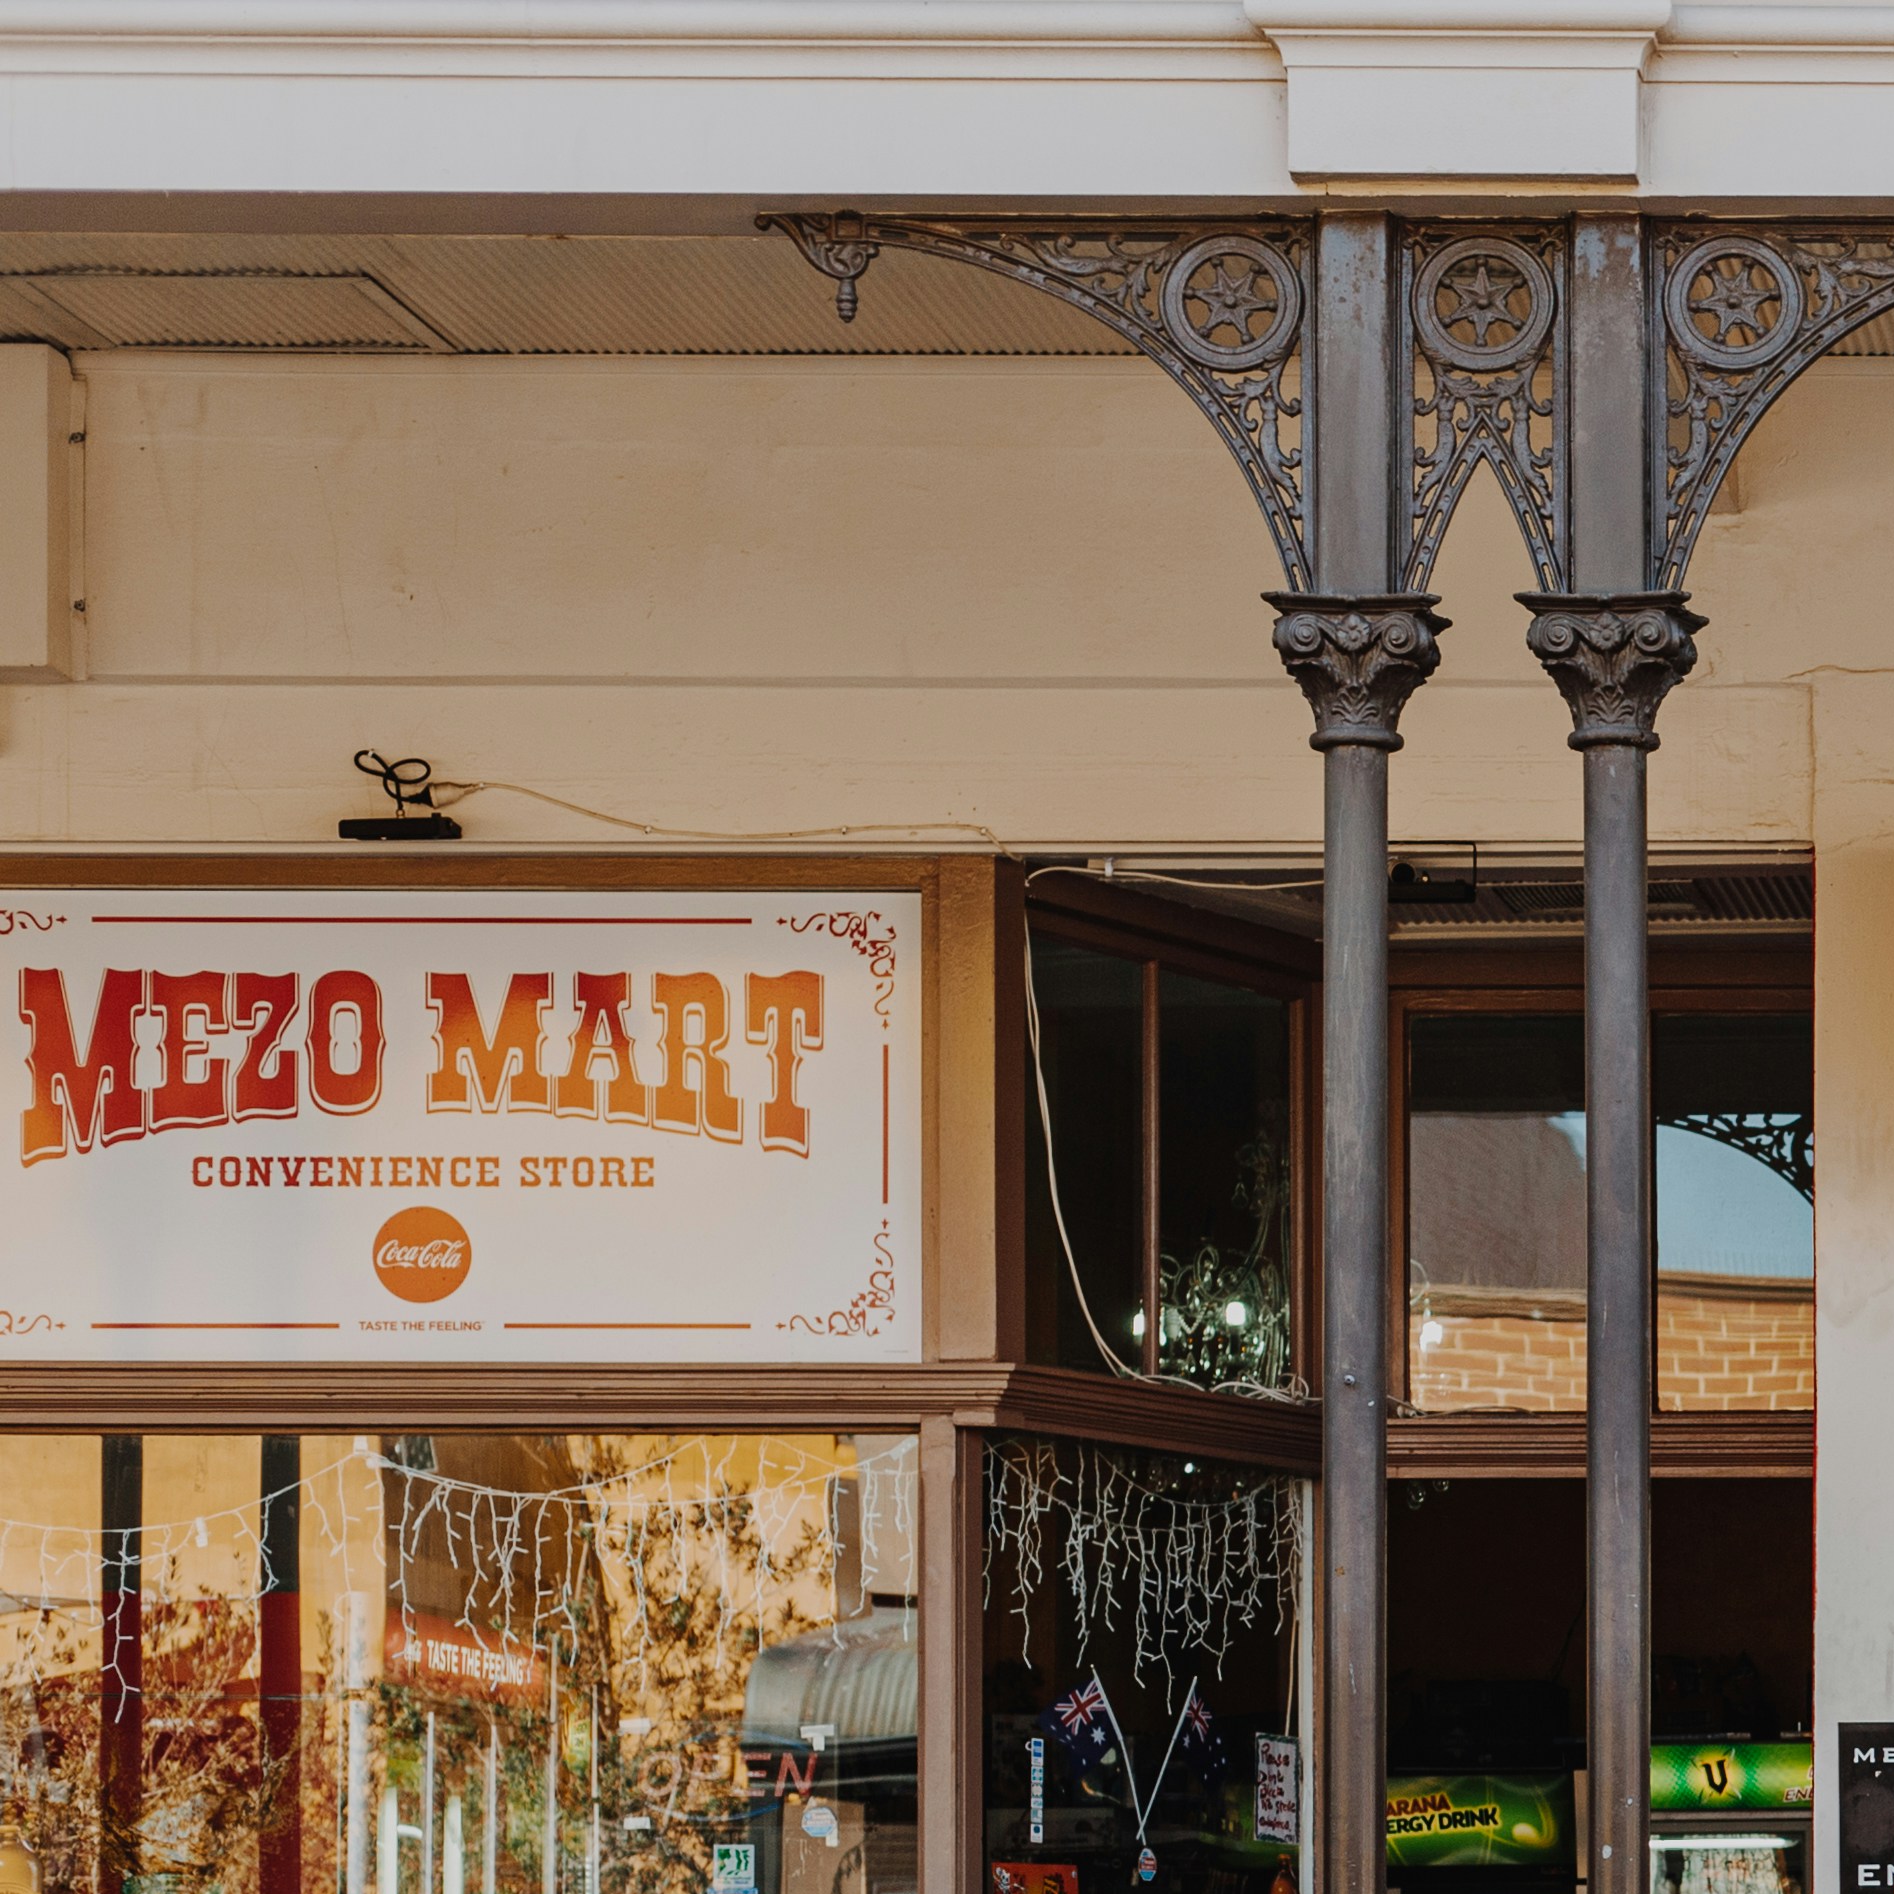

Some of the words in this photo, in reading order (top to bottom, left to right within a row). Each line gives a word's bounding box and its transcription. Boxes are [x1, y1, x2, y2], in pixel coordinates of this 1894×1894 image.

[19, 966, 388, 1160] MEZO
[425, 969, 825, 1160] MART
[191, 1155, 501, 1188] CONVENIENCE
[519, 1155, 656, 1188] STORE
[376, 1238, 463, 1270] Coca-Cola
[359, 1321, 401, 1331] TASTE
[403, 1321, 426, 1331] THE
[428, 1321, 482, 1331] FEELING
[427, 1639, 459, 1674] TASTE
[461, 1647, 480, 1678] THE
[483, 1650, 523, 1685] FEELING
[638, 1752, 818, 1797] OPEN
[1440, 1808, 1498, 1830] DRINK
